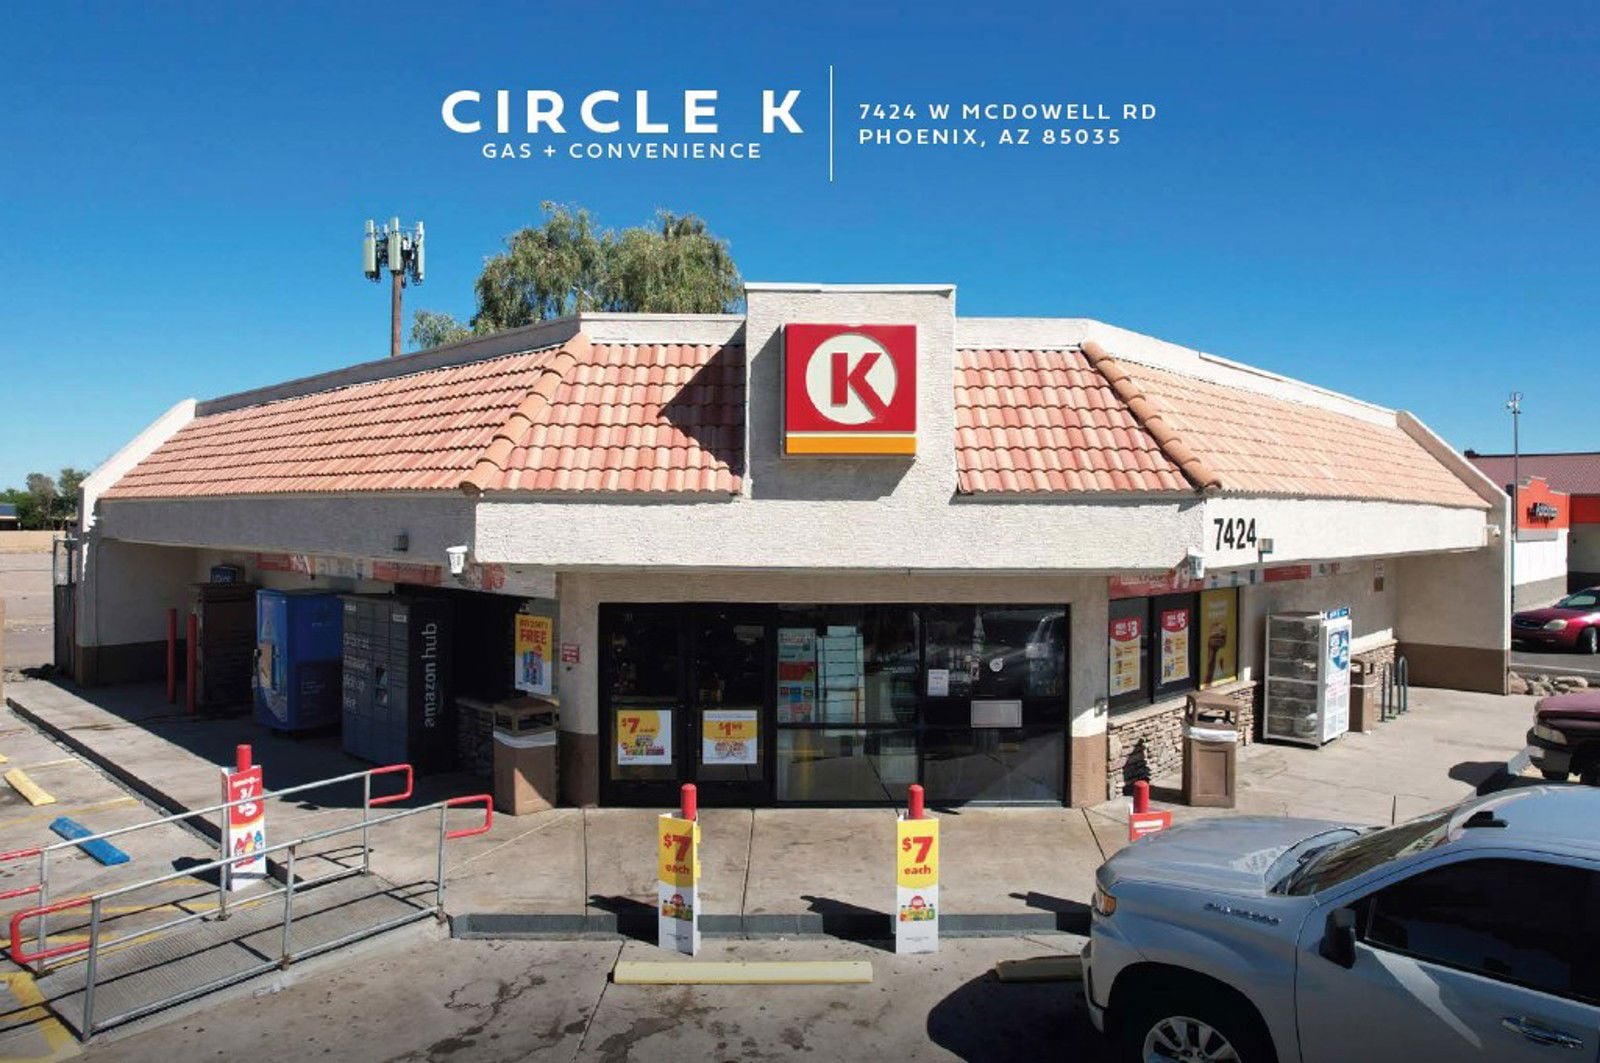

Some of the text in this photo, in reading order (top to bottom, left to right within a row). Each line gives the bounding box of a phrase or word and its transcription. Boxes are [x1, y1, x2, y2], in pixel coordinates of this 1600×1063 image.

[831, 352, 890, 419] K
[1214, 518, 1257, 551] 7424
[521, 629, 547, 644] FREE
[421, 623, 438, 728] amazon hub
[663, 833, 692, 863] $7
[902, 836, 934, 864] $7
[665, 863, 690, 875] each
[903, 865, 932, 875] each
